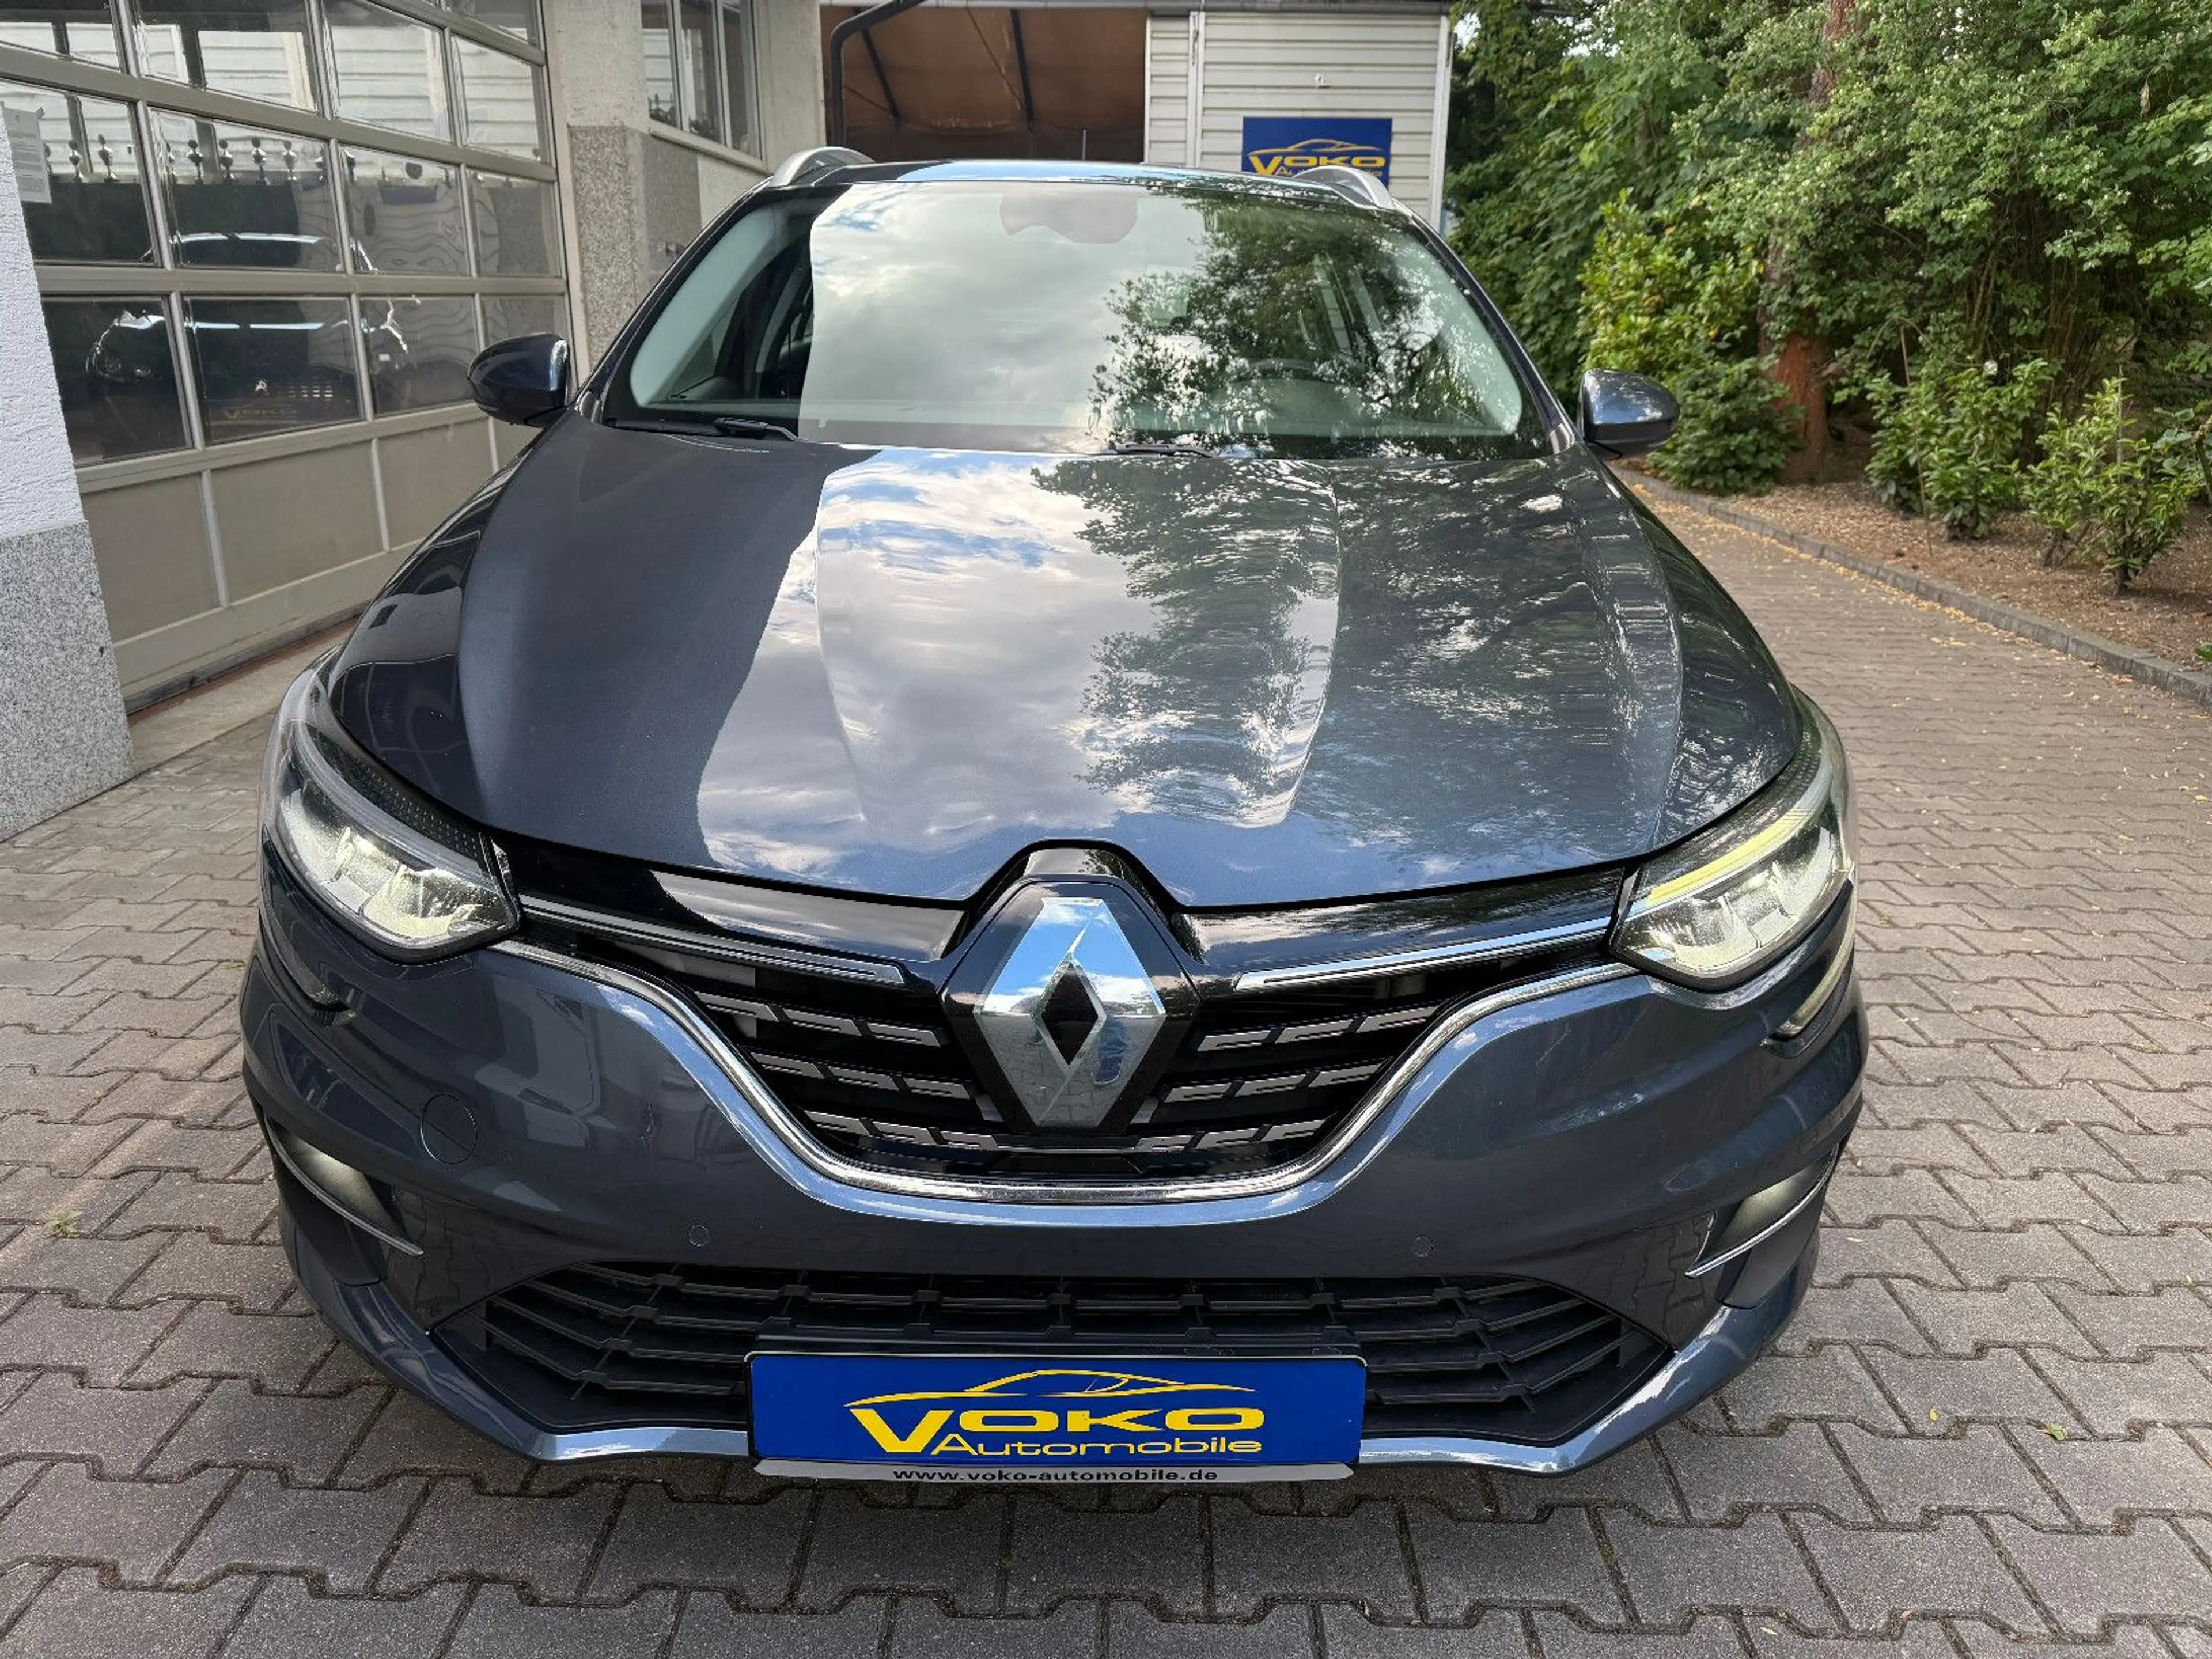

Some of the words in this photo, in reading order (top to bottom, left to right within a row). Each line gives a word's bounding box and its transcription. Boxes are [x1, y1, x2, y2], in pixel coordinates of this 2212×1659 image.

[1248, 156, 1385, 175] VOKO
[850, 1408, 1265, 1453] VOKO
[930, 1433, 1262, 1456] Automobile
[893, 1469, 1218, 1481] www.voko-automobile.de
